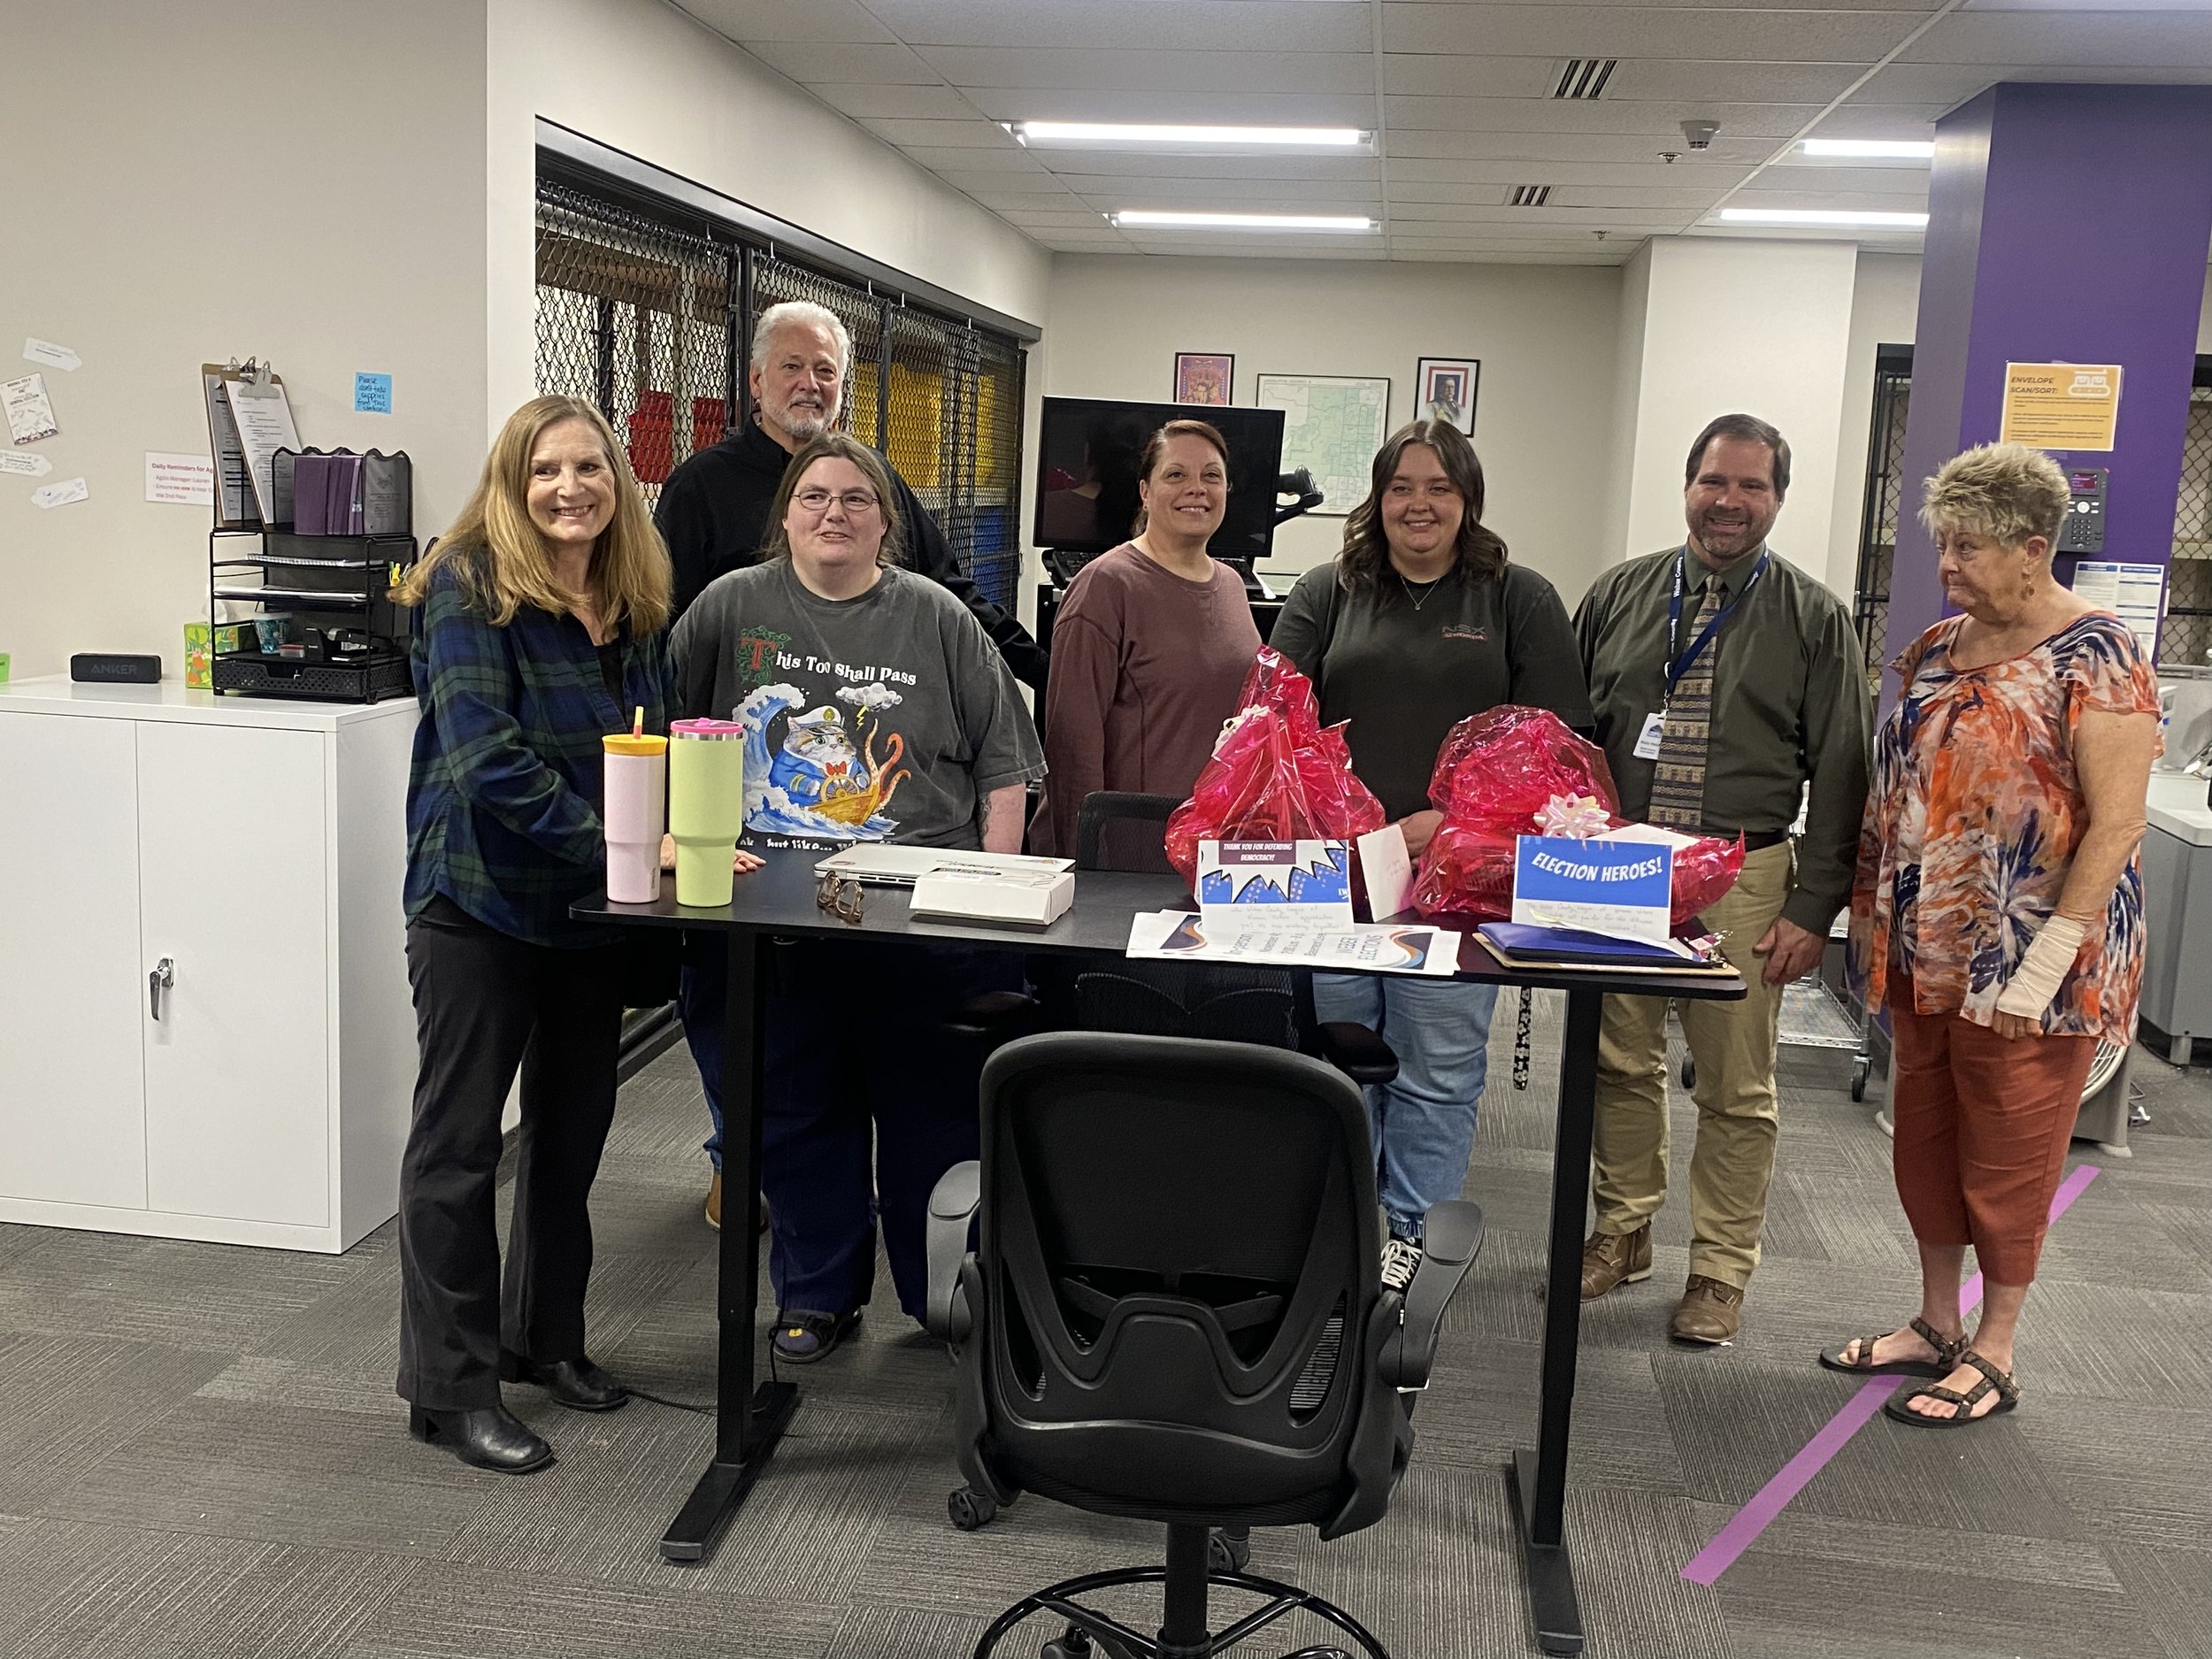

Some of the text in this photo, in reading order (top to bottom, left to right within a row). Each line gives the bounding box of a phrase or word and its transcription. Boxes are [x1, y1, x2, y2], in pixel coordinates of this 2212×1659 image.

[90, 664, 137, 675] ANKER
[805, 656, 830, 674] Too
[834, 663, 875, 682] Shall
[879, 667, 917, 687] Pass
[1532, 852, 1663, 882] ELECTION HEROES!
